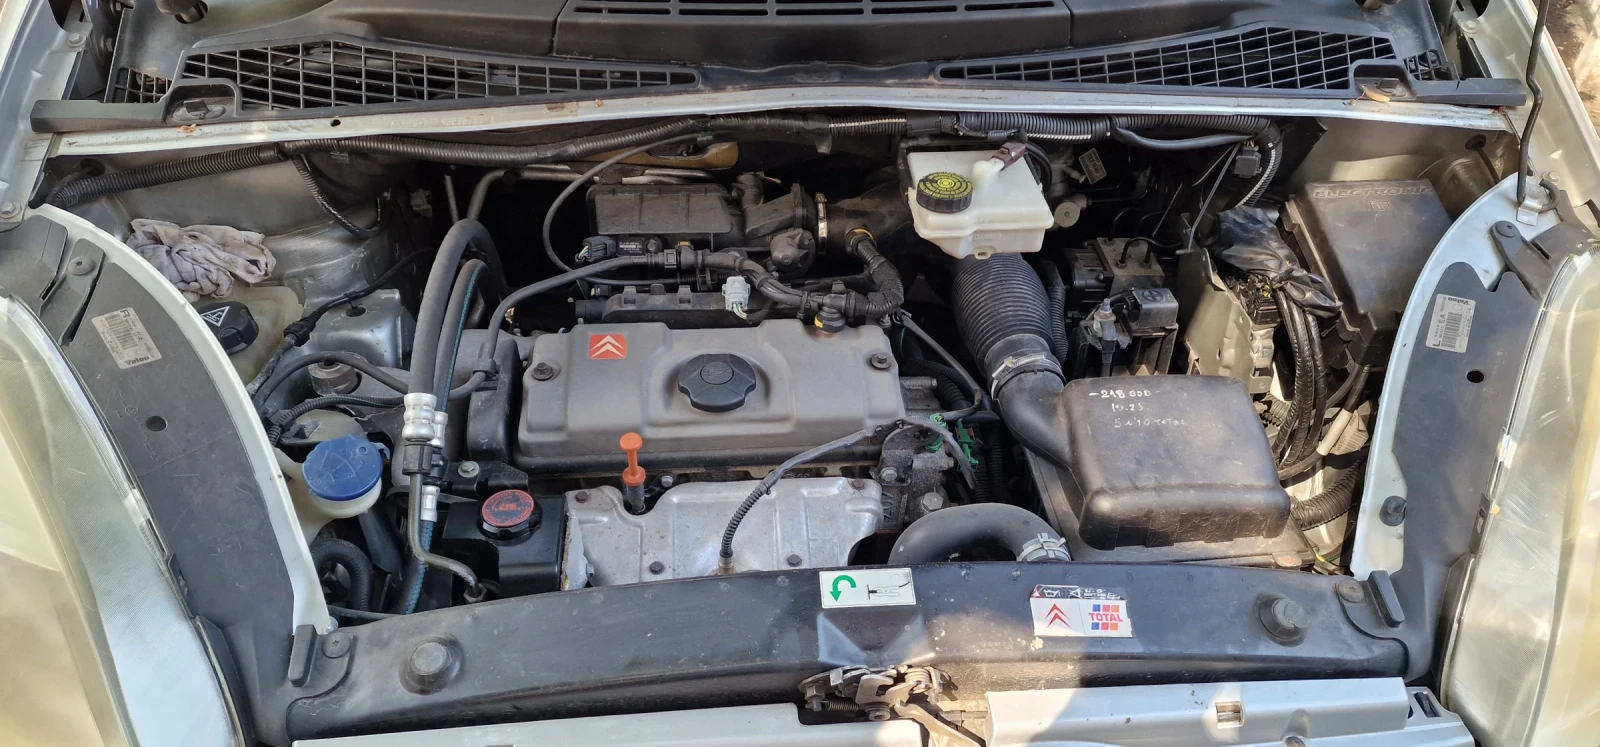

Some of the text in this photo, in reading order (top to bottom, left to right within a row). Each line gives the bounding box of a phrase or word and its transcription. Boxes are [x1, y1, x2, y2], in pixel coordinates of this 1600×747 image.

[1447, 296, 1470, 306] Valeo
[124, 355, 150, 366] Valeo
[1087, 612, 1124, 623] TOTAL
